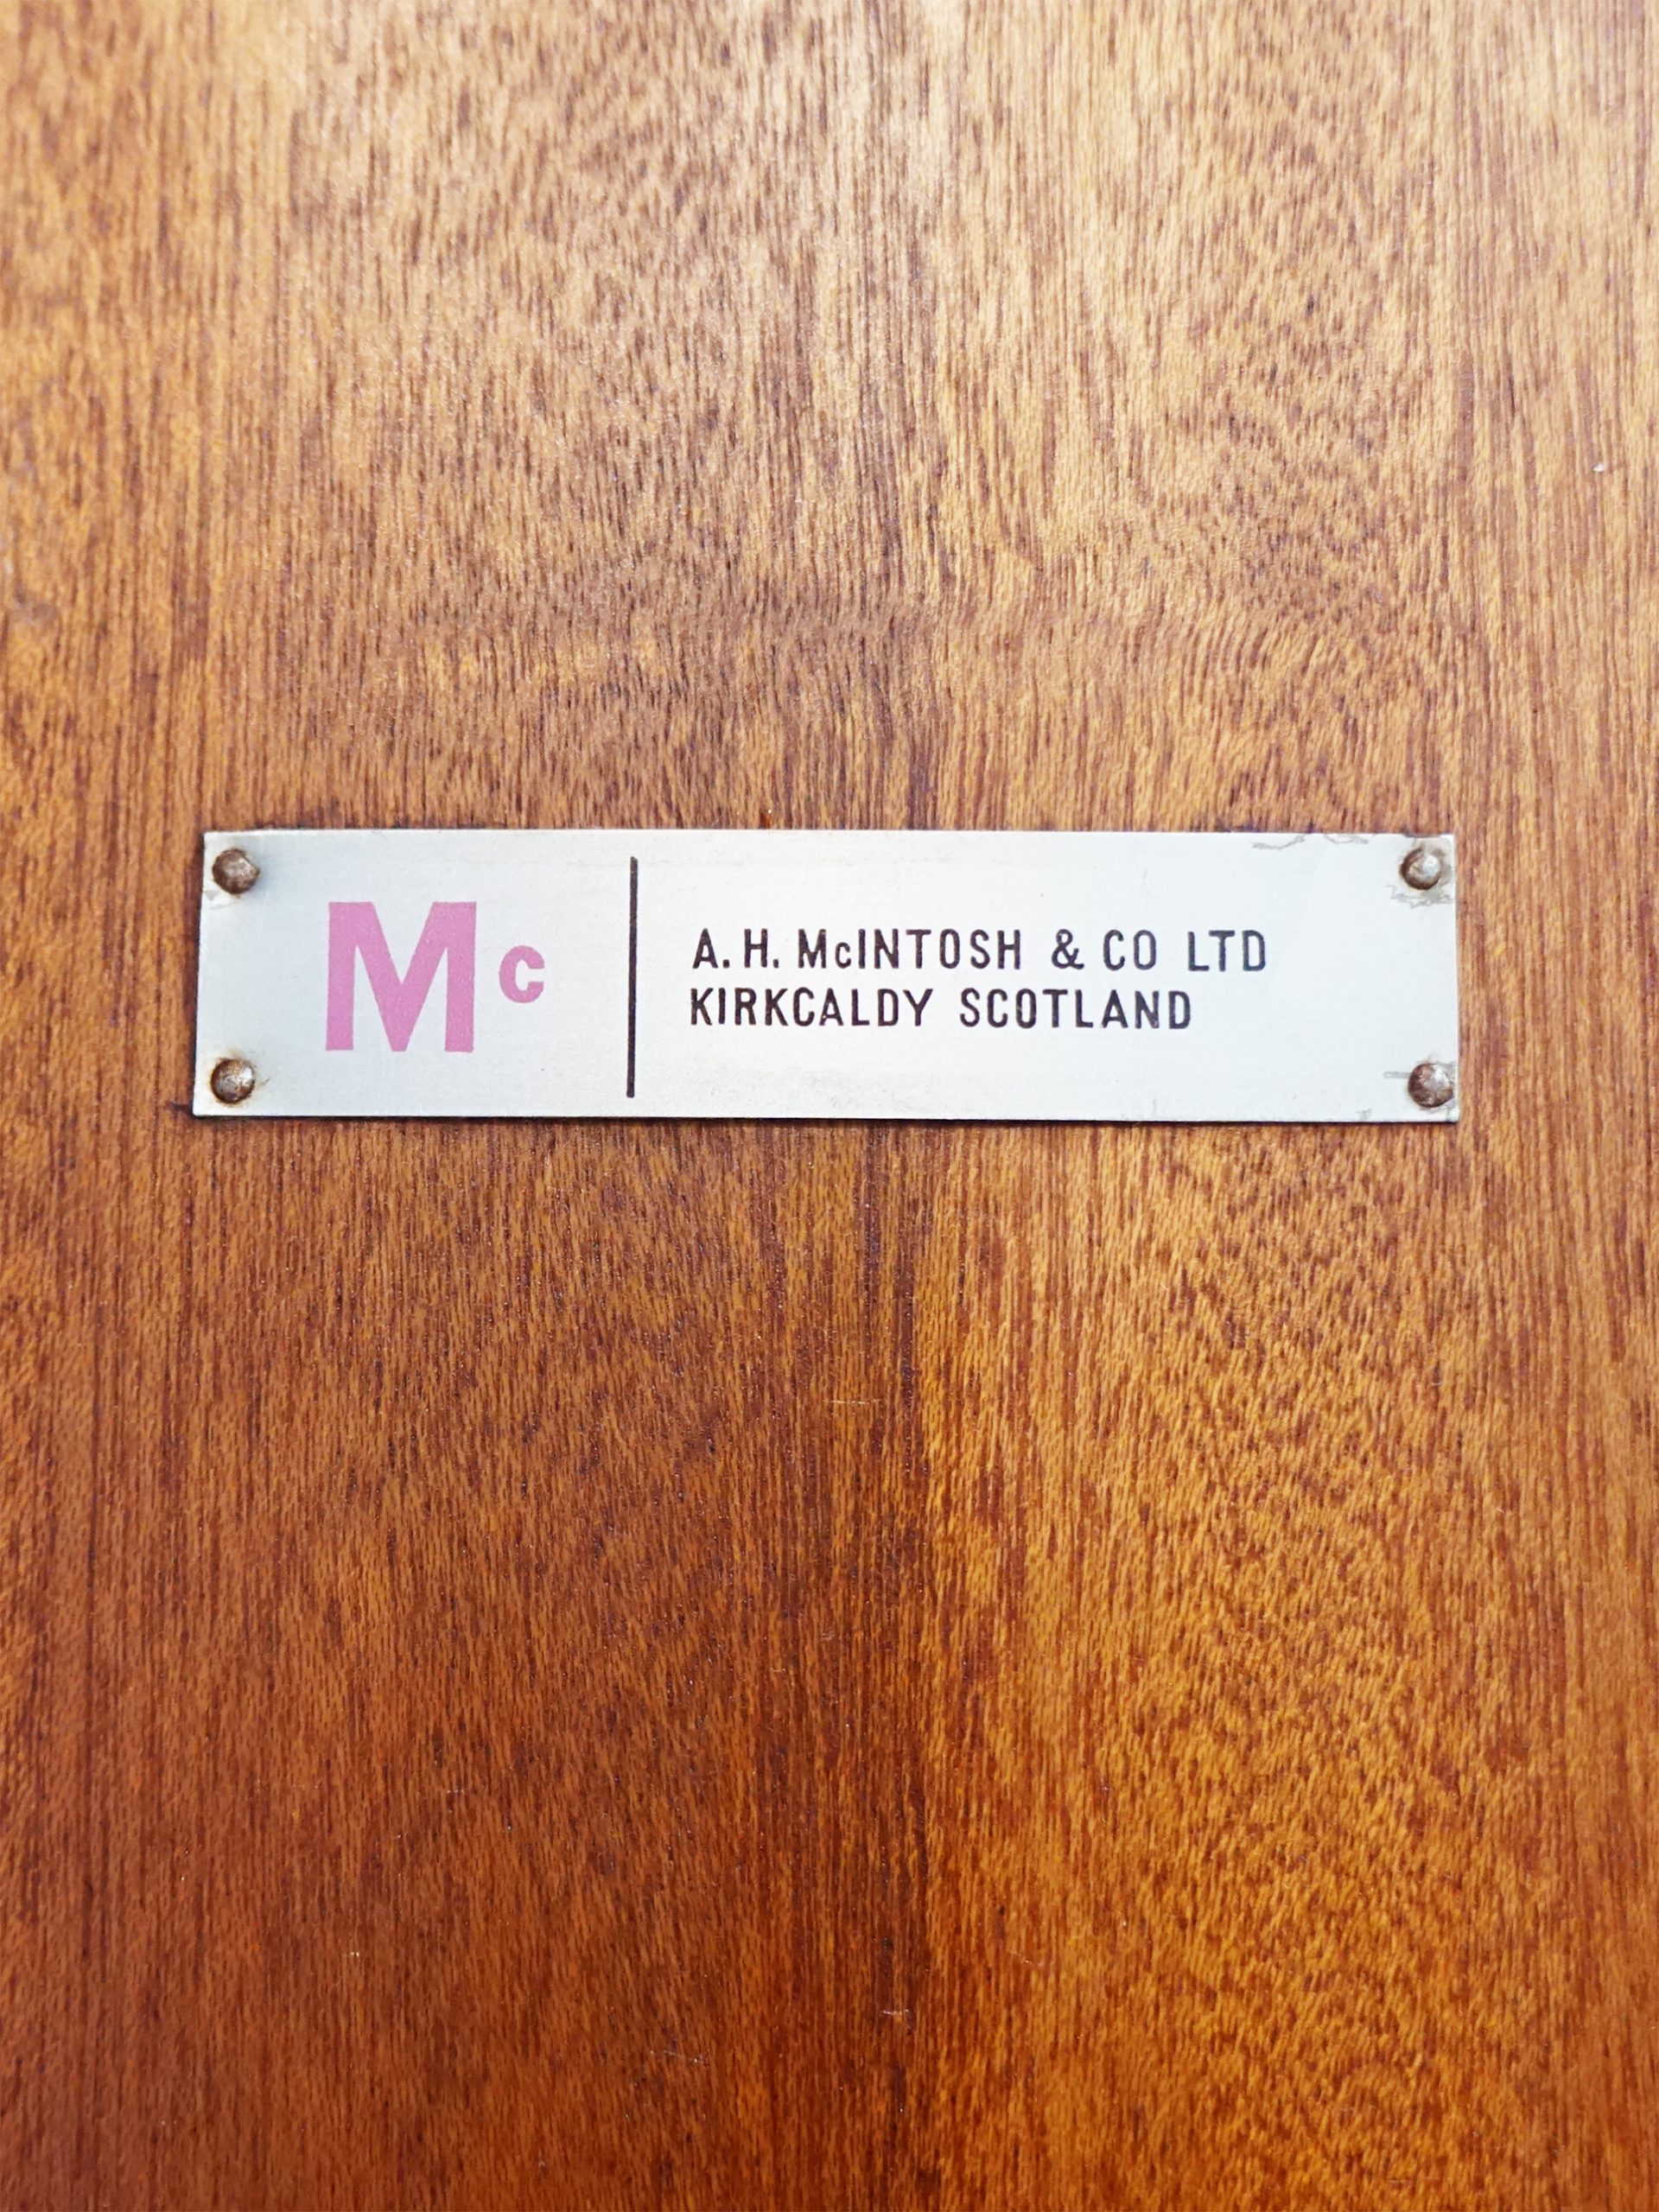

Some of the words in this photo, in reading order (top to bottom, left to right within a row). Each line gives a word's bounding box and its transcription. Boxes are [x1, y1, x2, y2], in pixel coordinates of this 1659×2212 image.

[798, 928, 1021, 970] McINTOSH
[1051, 928, 1085, 970] &
[1103, 929, 1157, 971] CO
[1188, 930, 1266, 972] LTD
[325, 901, 545, 1053] Mc
[690, 987, 933, 1027] KIRKCALDY
[959, 987, 1191, 1030] SCOTLAND
